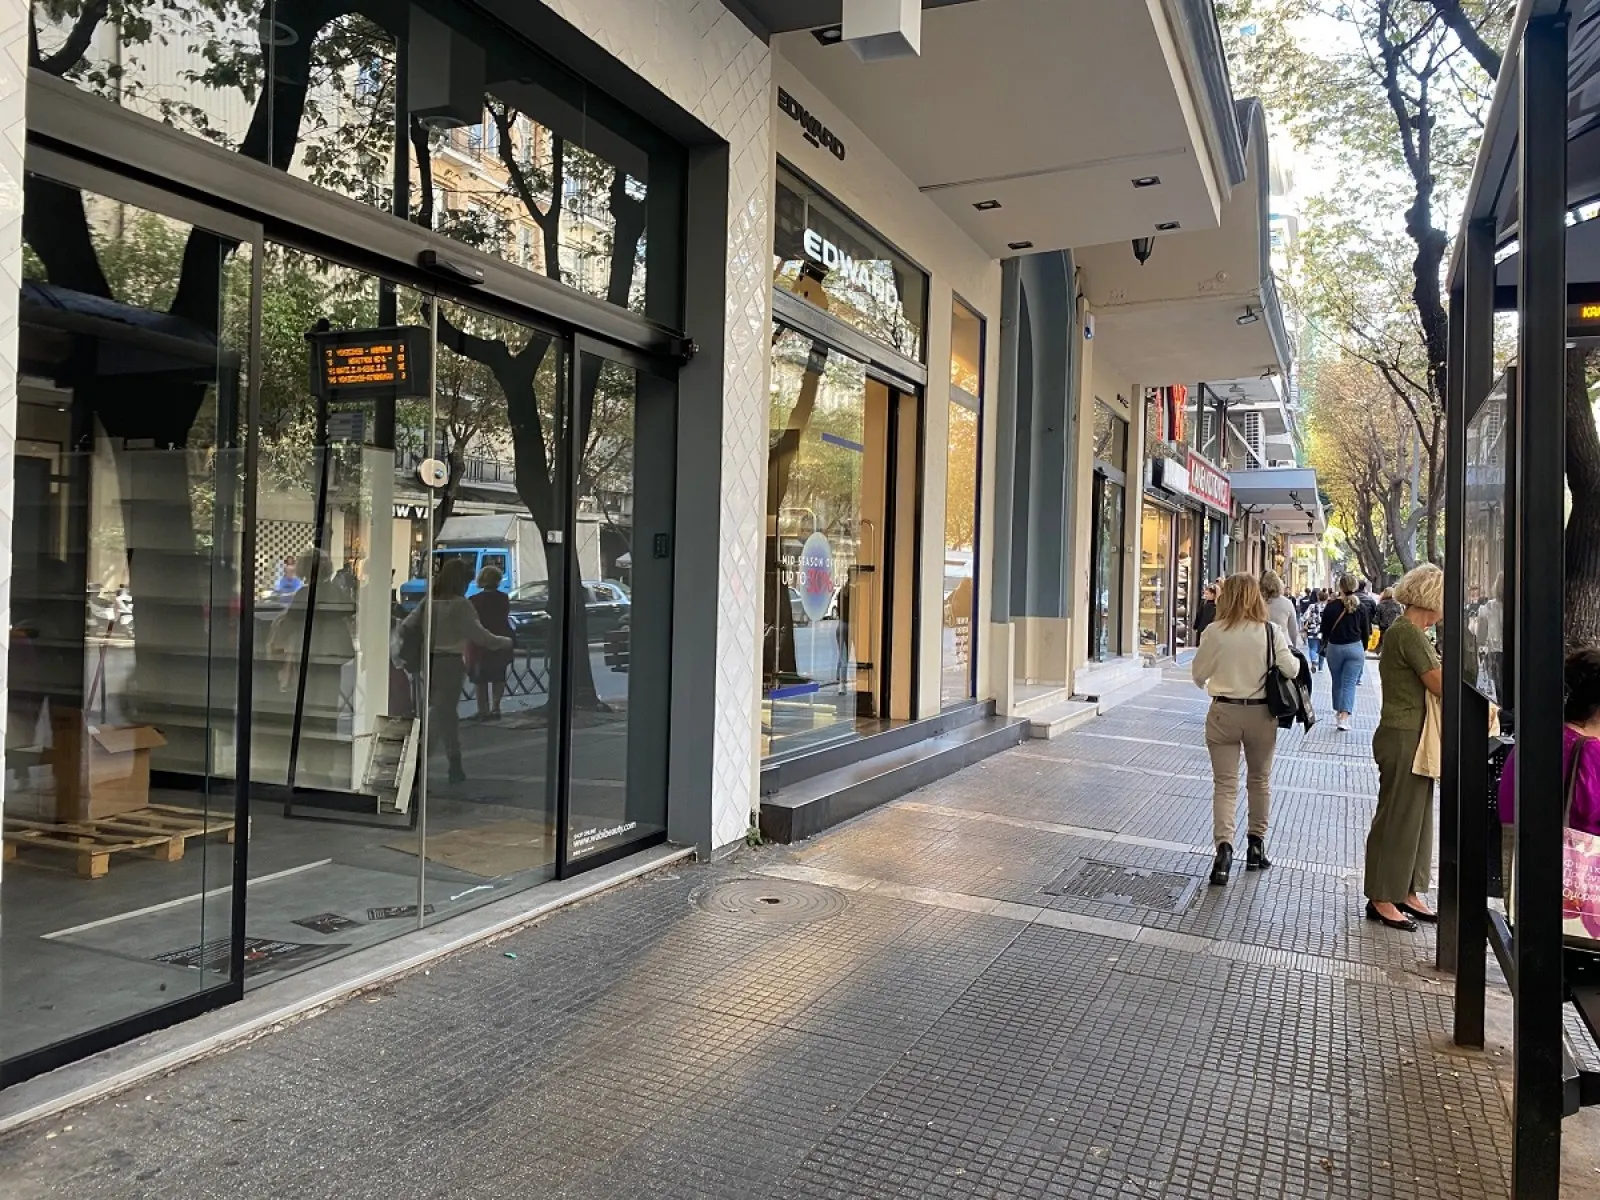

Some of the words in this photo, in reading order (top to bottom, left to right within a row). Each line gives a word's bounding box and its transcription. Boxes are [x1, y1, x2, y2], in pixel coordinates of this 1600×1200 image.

[777, 86, 846, 161] EDWARD
[803, 227, 900, 307] EDWARD
[782, 555, 796, 565] MID
[798, 554, 825, 568] SEASON
[782, 570, 794, 585] UP
[795, 570, 806, 585] TO
